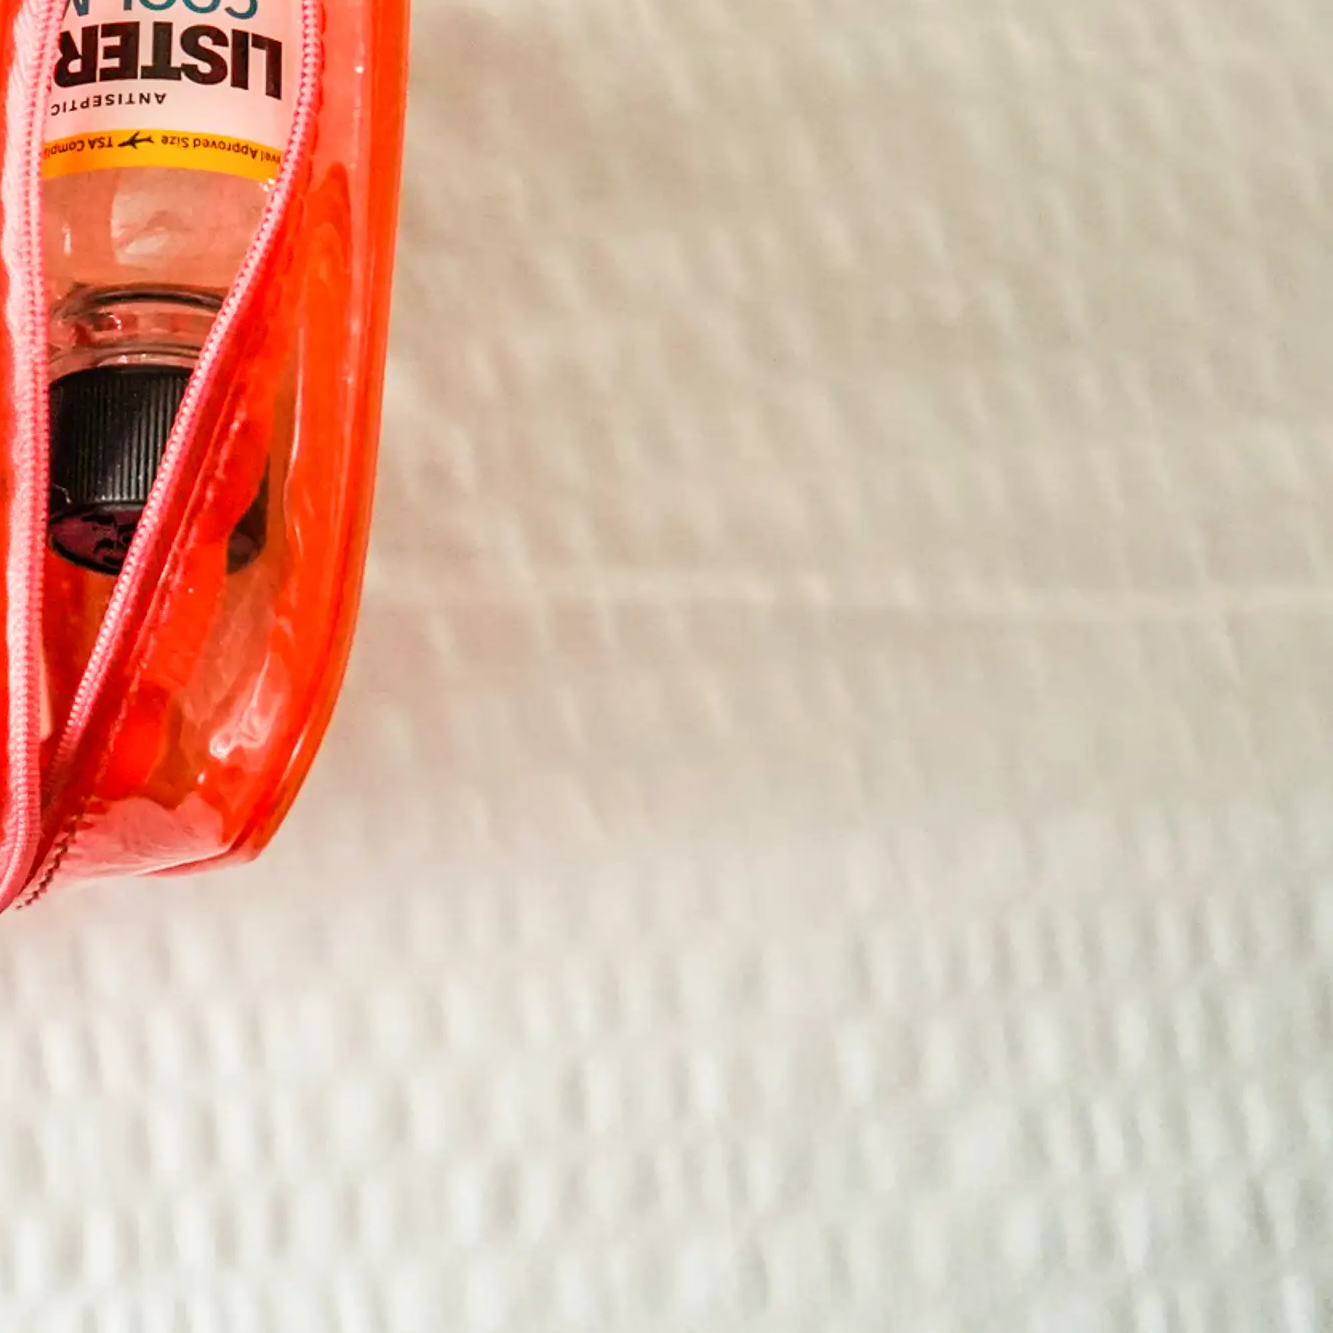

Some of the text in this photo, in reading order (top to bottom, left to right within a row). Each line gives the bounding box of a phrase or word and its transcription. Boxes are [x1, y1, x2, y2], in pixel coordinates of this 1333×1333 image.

[50, 92, 167, 116] ANTISEPTIC
[43, 140, 85, 160] Compli
[88, 136, 113, 150] TSA
[161, 136, 189, 148] Size
[193, 138, 257, 160] Approved
